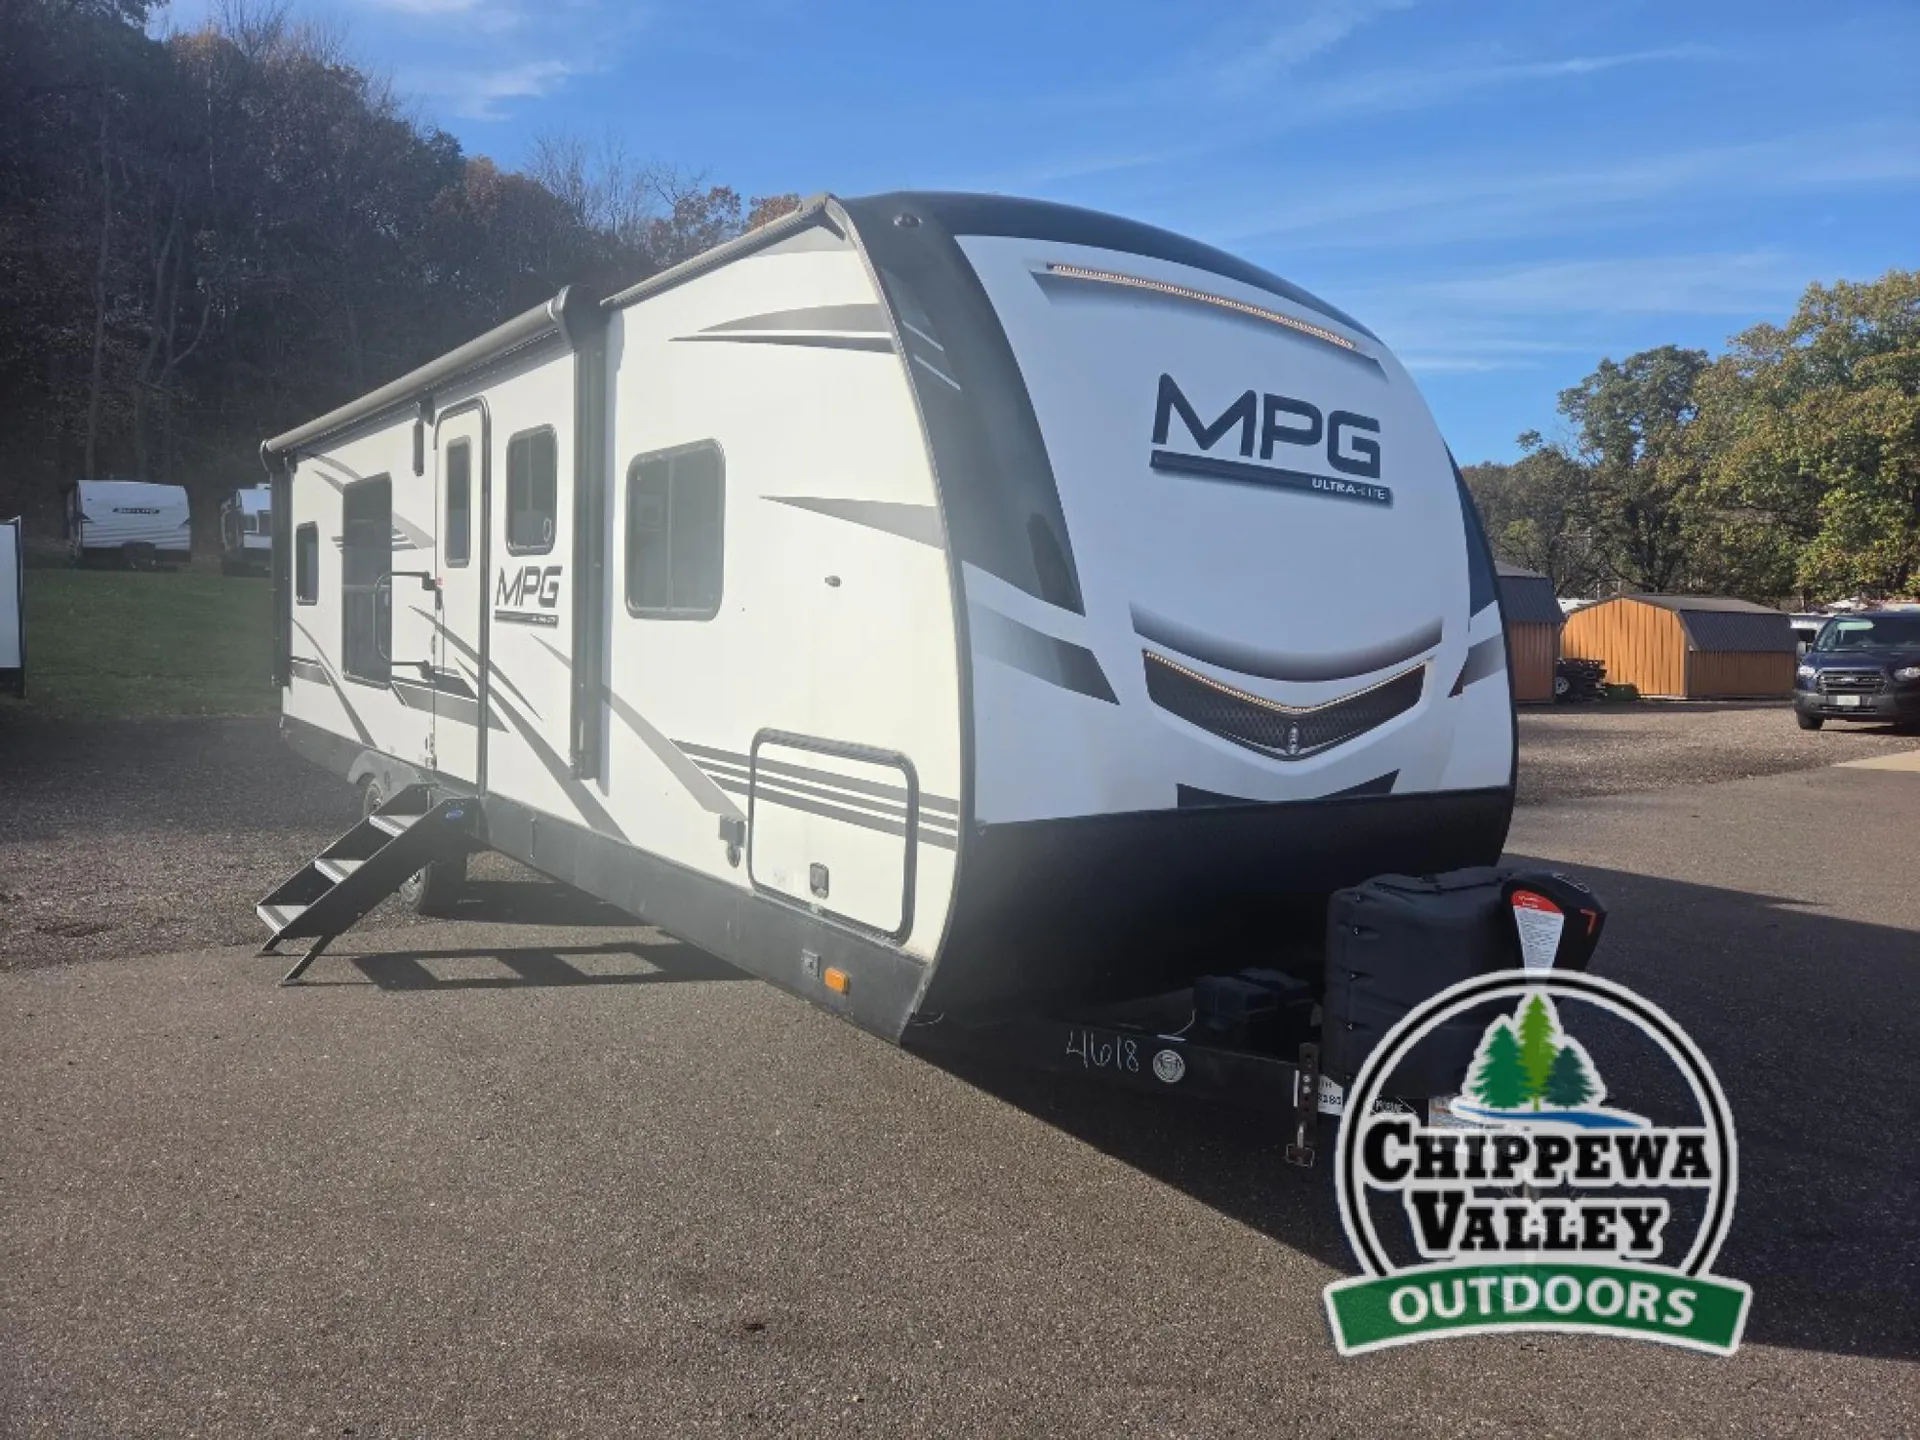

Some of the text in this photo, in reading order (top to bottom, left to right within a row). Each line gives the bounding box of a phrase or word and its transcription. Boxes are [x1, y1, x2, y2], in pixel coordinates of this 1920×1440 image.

[1151, 373, 1381, 479] MPG
[495, 565, 563, 608] MPG
[1066, 1031, 1139, 1072] 4618
